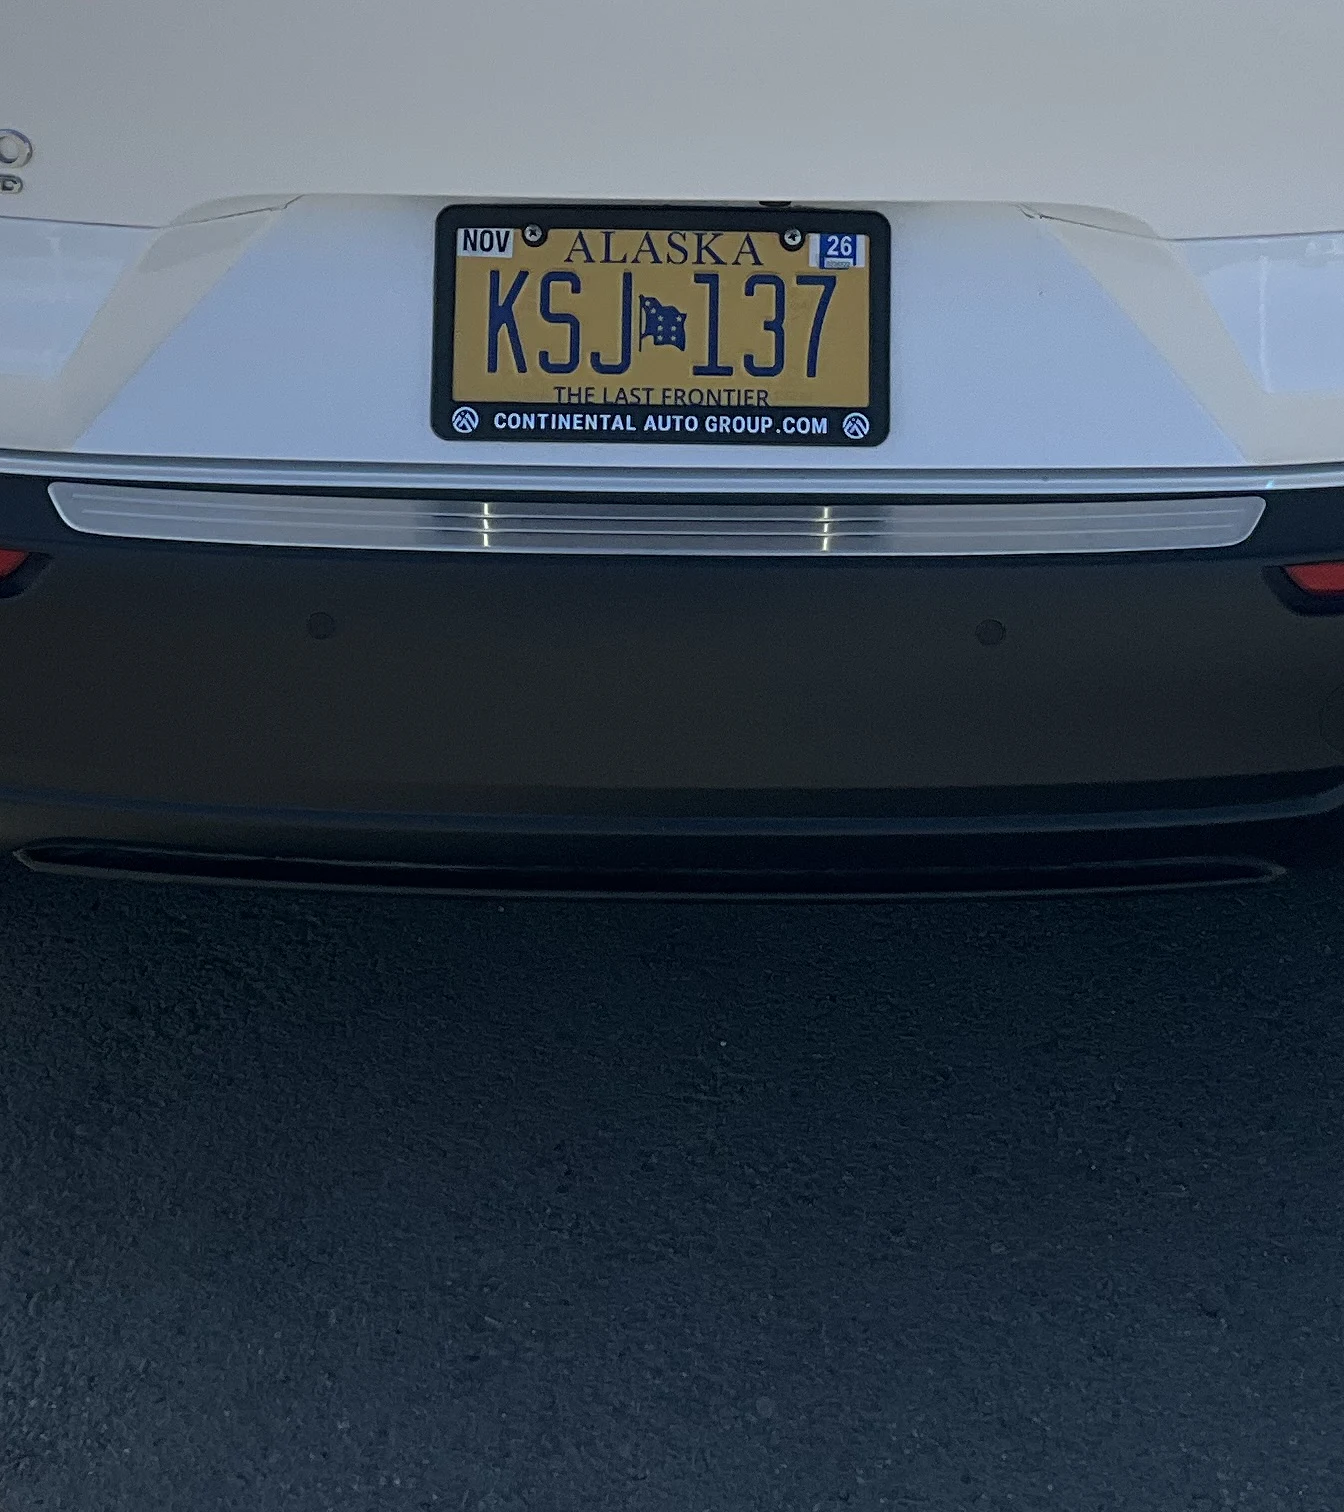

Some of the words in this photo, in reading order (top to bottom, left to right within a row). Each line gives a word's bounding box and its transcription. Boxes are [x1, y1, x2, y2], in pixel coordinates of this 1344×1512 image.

[462, 229, 510, 253] NOV
[563, 230, 764, 266] ALASKA
[826, 235, 853, 256] 26
[487, 269, 633, 375] KSJ
[692, 273, 837, 378] 137
[554, 386, 596, 405] THE
[603, 387, 655, 406] LAST
[662, 388, 770, 407] FRONTIER
[494, 412, 637, 431] CONTINENTAL
[643, 414, 699, 432] AUTO
